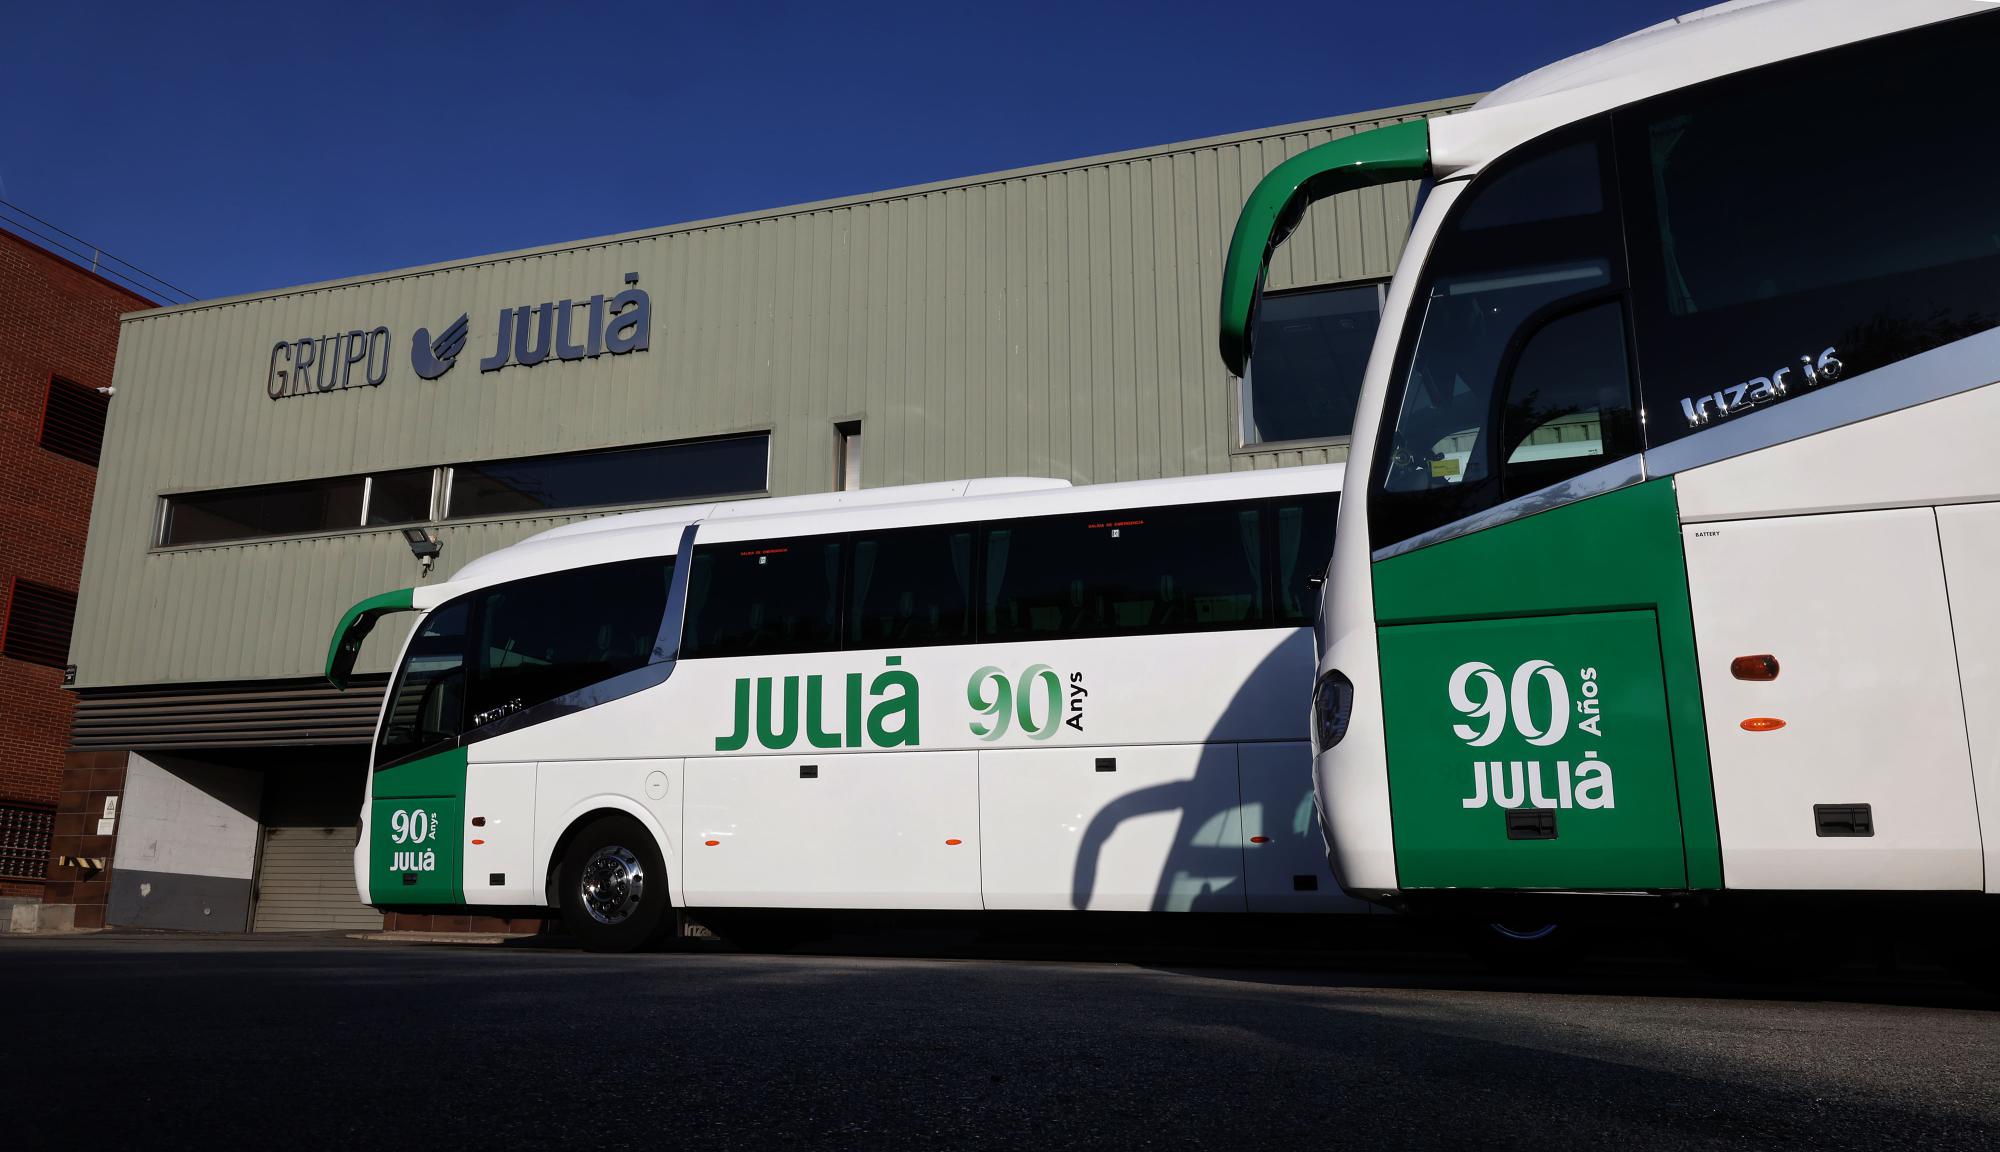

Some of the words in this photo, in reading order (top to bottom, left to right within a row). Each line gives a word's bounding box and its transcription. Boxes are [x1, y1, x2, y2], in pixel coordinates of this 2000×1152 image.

[267, 326, 391, 400] GRUPO
[1680, 367, 1791, 428] Irizar
[1800, 346, 1843, 386] i6
[967, 664, 1063, 742] 90
[1066, 671, 1088, 732] Anys
[1448, 659, 1570, 747] 90
[1576, 667, 1602, 736] Años
[391, 809, 428, 844] 90
[429, 812, 438, 840] Anys
